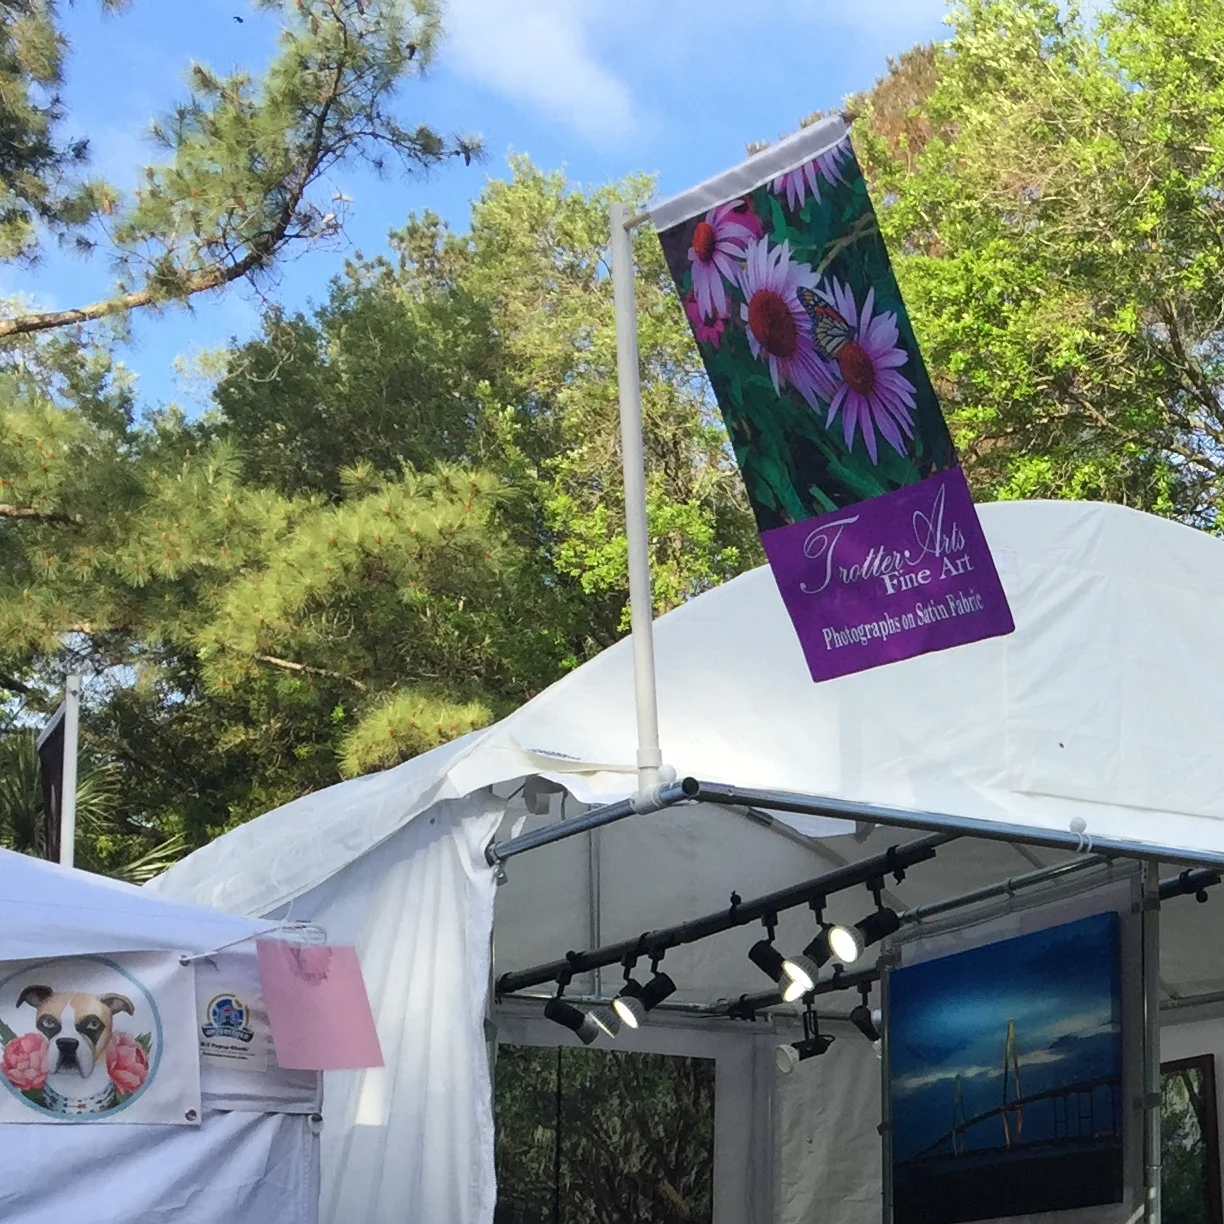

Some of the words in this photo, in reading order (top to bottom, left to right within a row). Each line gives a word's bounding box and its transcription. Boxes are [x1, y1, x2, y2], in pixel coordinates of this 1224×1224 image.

[800, 515, 903, 595] Trotter
[904, 483, 965, 566] Arts
[882, 568, 932, 596] Fine
[939, 553, 974, 579] Art
[822, 612, 901, 650] Photographs
[902, 613, 916, 631] on
[915, 599, 949, 626] Satin
[946, 587, 984, 617] Fabric
